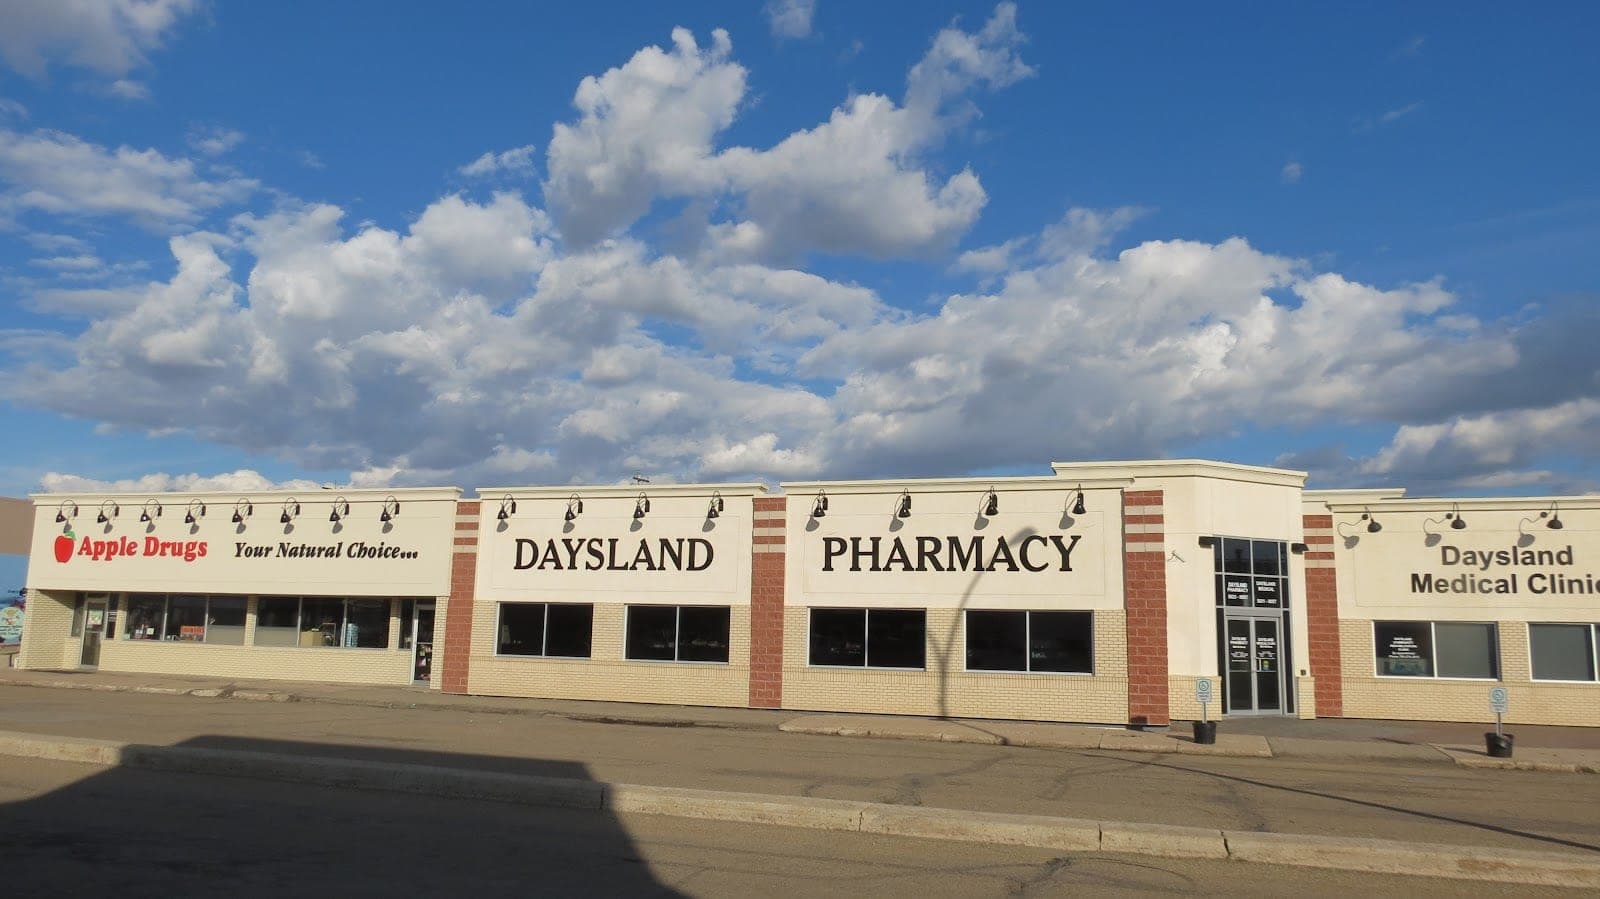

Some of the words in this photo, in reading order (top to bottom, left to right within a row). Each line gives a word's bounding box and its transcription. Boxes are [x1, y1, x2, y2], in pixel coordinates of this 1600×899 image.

[78, 536, 138, 561] Apple
[143, 536, 208, 562] Drugs
[234, 542, 273, 558] Your
[276, 541, 343, 558] Natural
[347, 541, 418, 559] Choice...
[513, 537, 715, 571] DAYSLAND
[822, 535, 1082, 573] PHARMACY
[1441, 545, 1574, 571] Daysland
[1411, 573, 1518, 594] Medical
